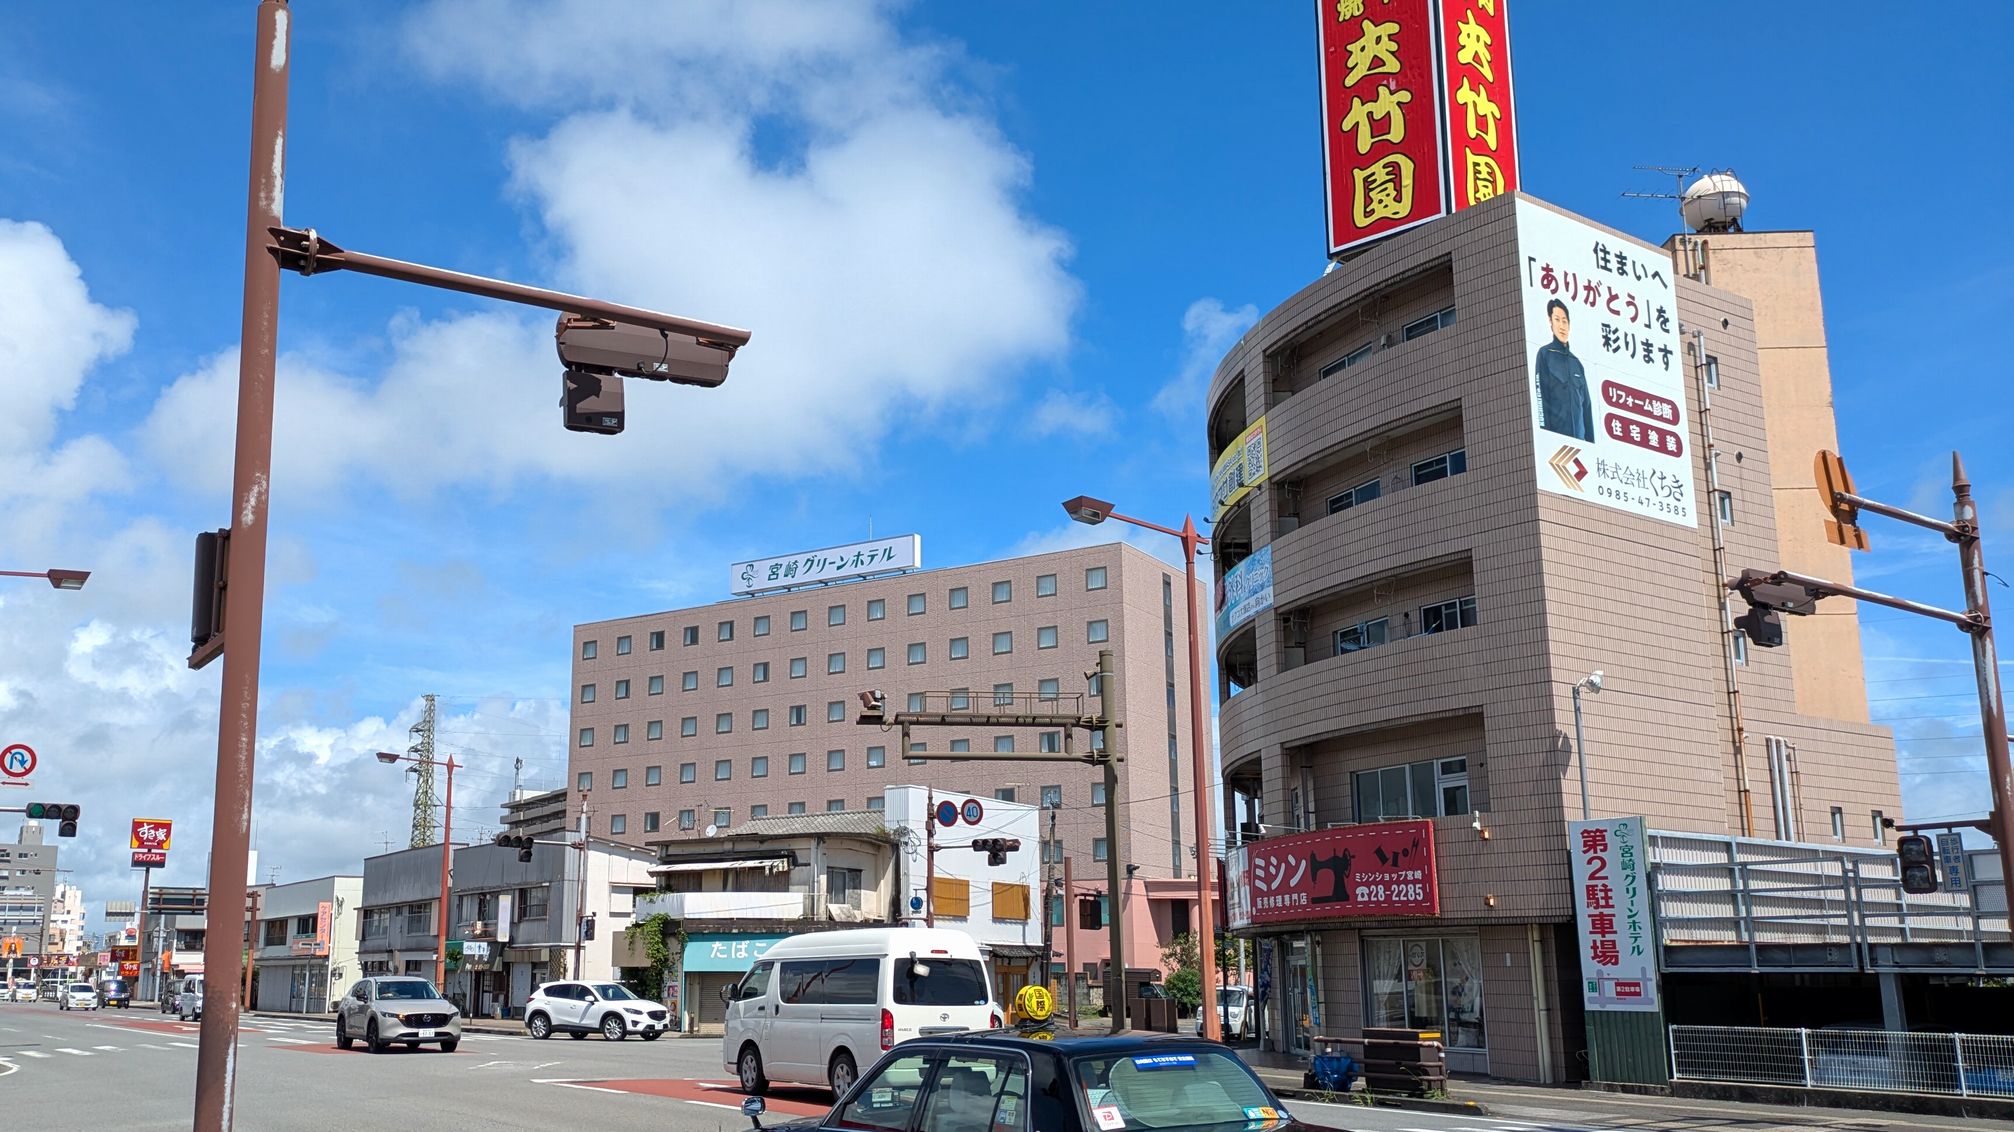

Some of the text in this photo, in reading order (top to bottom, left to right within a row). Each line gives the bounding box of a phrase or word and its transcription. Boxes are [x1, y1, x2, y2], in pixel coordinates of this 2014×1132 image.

[1593, 240, 1668, 290] 住まいへ
[1527, 255, 1670, 334] 「ありがとう」を
[1601, 322, 1673, 371] 彩ります
[1608, 386, 1673, 421] リフォーム診断
[1611, 418, 1677, 453] 住宅塗装
[1596, 457, 1684, 502] 株式会社くちき
[1597, 485, 1688, 518] 0985-47-3585
[767, 545, 897, 581] 宮崎グリーンホテル
[966, 805, 979, 818] 40
[1254, 853, 1307, 893] ミシン
[1355, 870, 1422, 882] ミシンショップ宮崎
[1370, 883, 1424, 901] 28-2285
[1580, 829, 1620, 967] 第2駐車場
[1619, 844, 1645, 957] 宮崎グリーンホテル
[710, 940, 768, 959] たばこ
